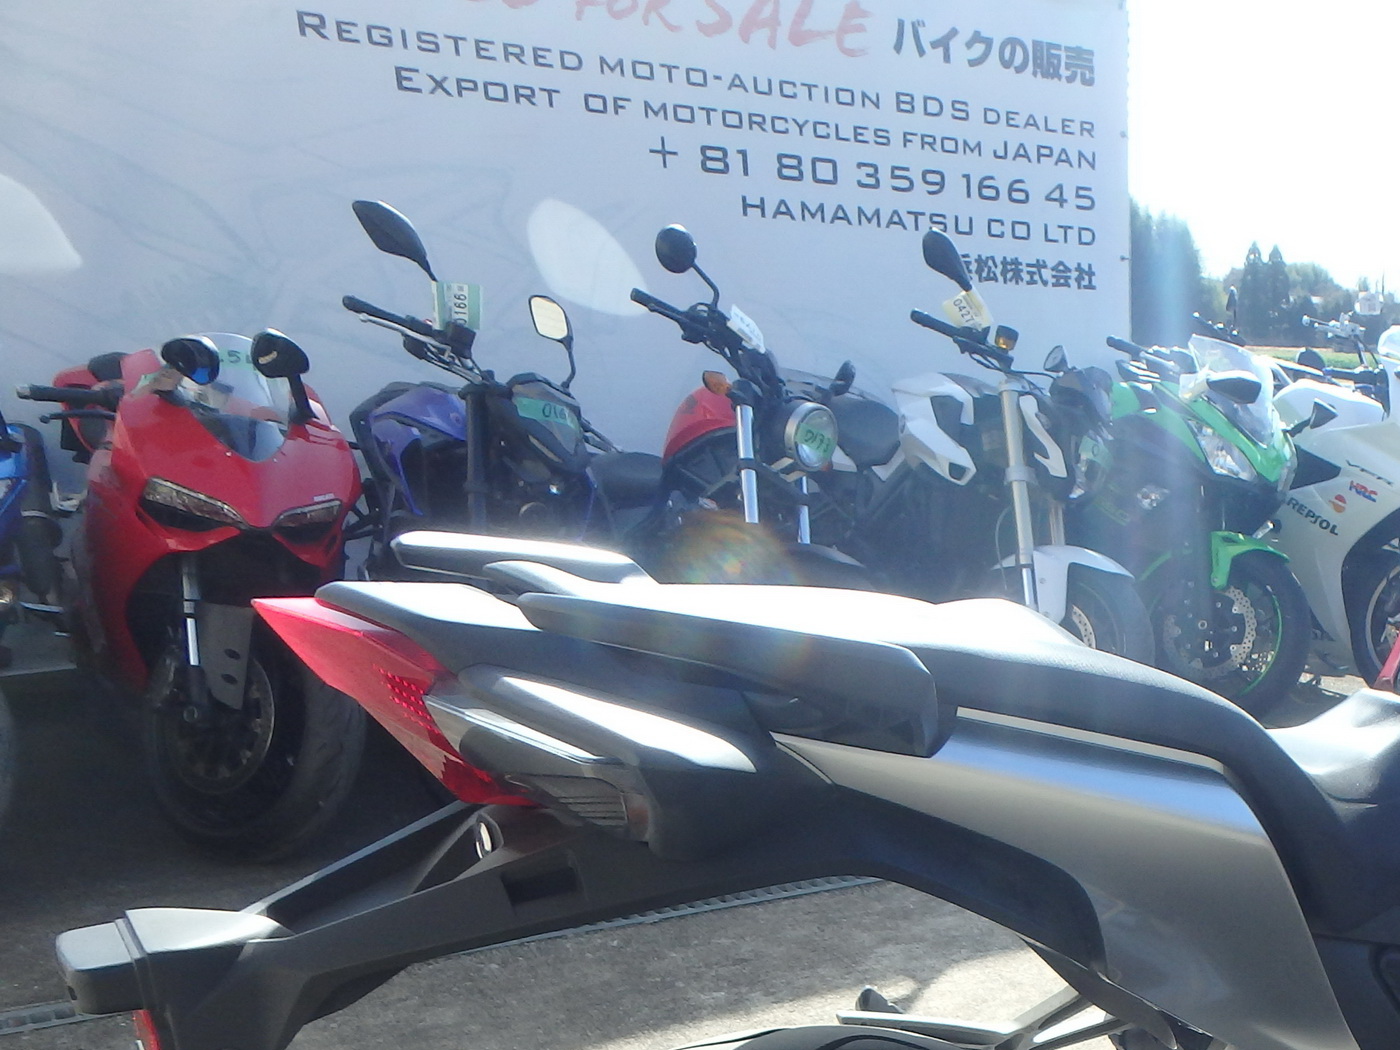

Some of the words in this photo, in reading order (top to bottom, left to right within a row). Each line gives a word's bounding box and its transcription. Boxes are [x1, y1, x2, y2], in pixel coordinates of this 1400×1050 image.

[696, 0, 874, 57] SALE
[893, 18, 1095, 87] バイクの販売
[296, 10, 584, 72] REGISTERED
[600, 55, 881, 110] MOTO-AUCTION
[895, 91, 970, 122] BDS
[983, 107, 1095, 138] DEALER
[394, 66, 561, 109] EXPORT
[583, 93, 632, 116] OF
[643, 100, 891, 146] MOTORCYCLES
[903, 131, 982, 157] FROM
[993, 140, 1096, 171] JAPAN
[700, 145, 749, 177] 81
[777, 153, 838, 185] 80
[856, 162, 946, 196] 359
[961, 173, 1030, 205] 166
[1044, 183, 1096, 211] 45
[741, 195, 973, 236] HAMAMATSU
[987, 218, 1031, 241] CO
[1044, 223, 1096, 246] LTD
[953, 298, 975, 323] 0427
[1286, 496, 1340, 536] REPSOL
[1349, 480, 1379, 502] HRC
